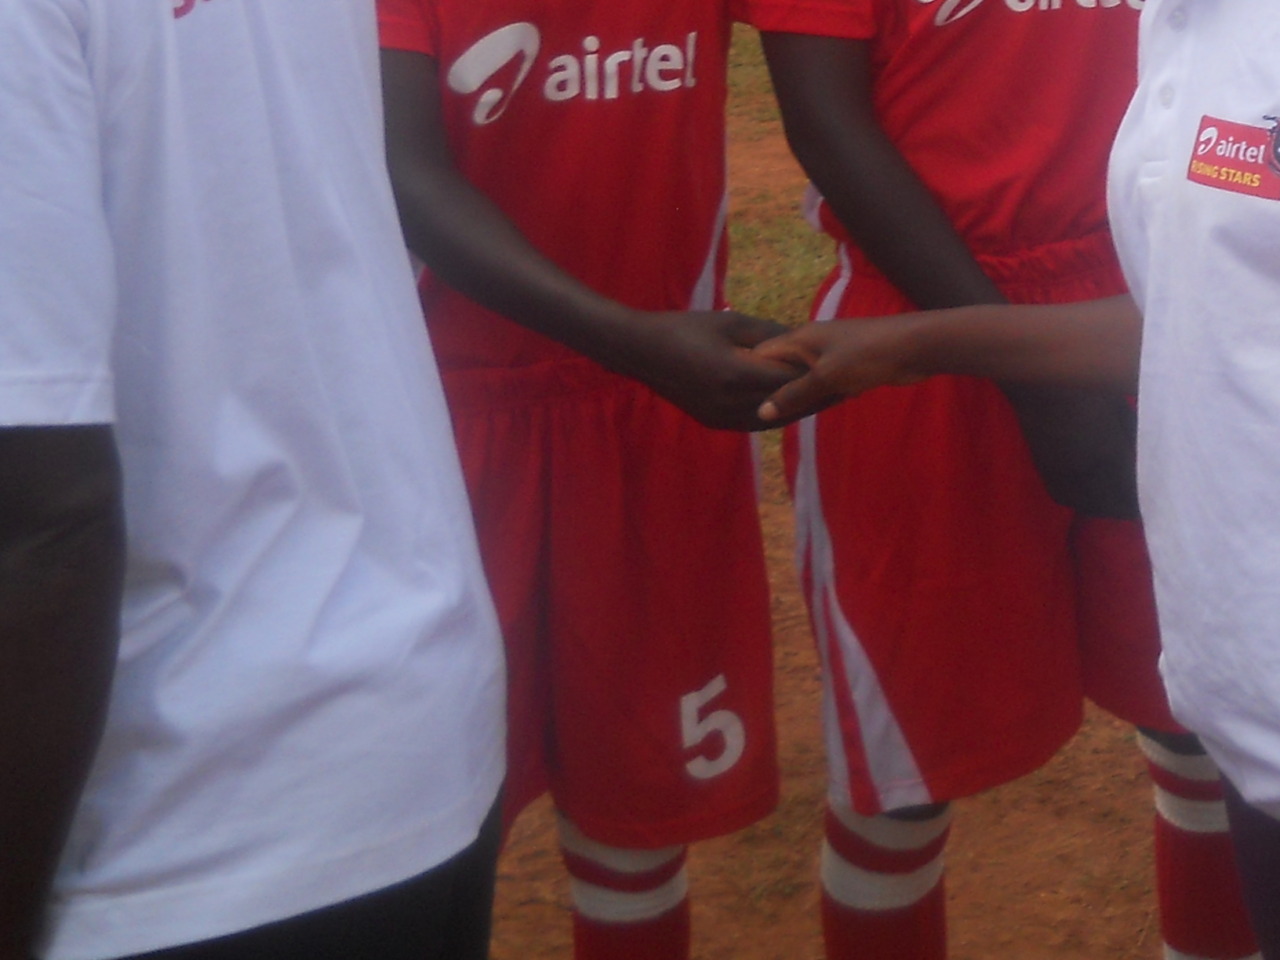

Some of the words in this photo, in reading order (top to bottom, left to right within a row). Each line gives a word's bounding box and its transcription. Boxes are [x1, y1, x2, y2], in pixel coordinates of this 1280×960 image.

[544, 31, 698, 102] airtel
[1215, 136, 1266, 164] airtel
[1219, 167, 1261, 187] STARS
[681, 673, 746, 780] 5
